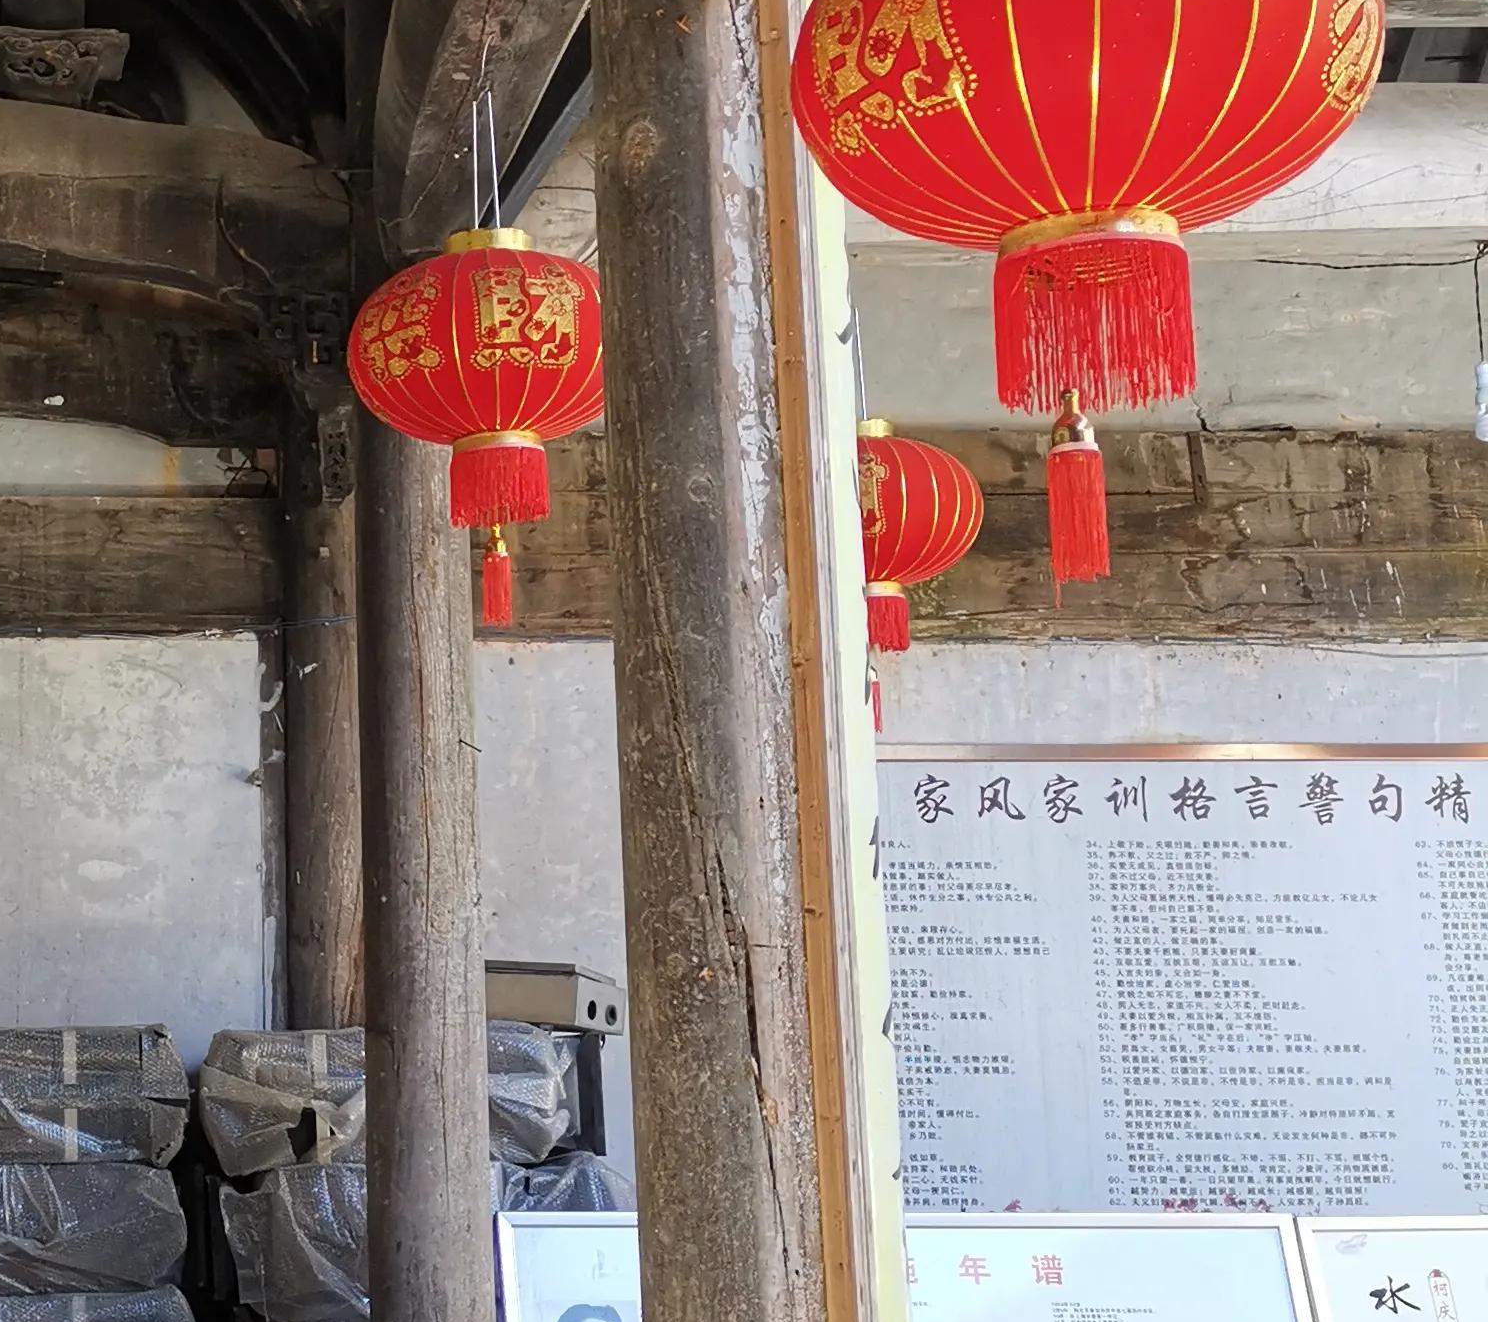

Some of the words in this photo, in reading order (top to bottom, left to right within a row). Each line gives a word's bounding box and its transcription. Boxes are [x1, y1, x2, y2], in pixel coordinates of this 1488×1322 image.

[913, 771, 1473, 826] 家风家训格言警句精
